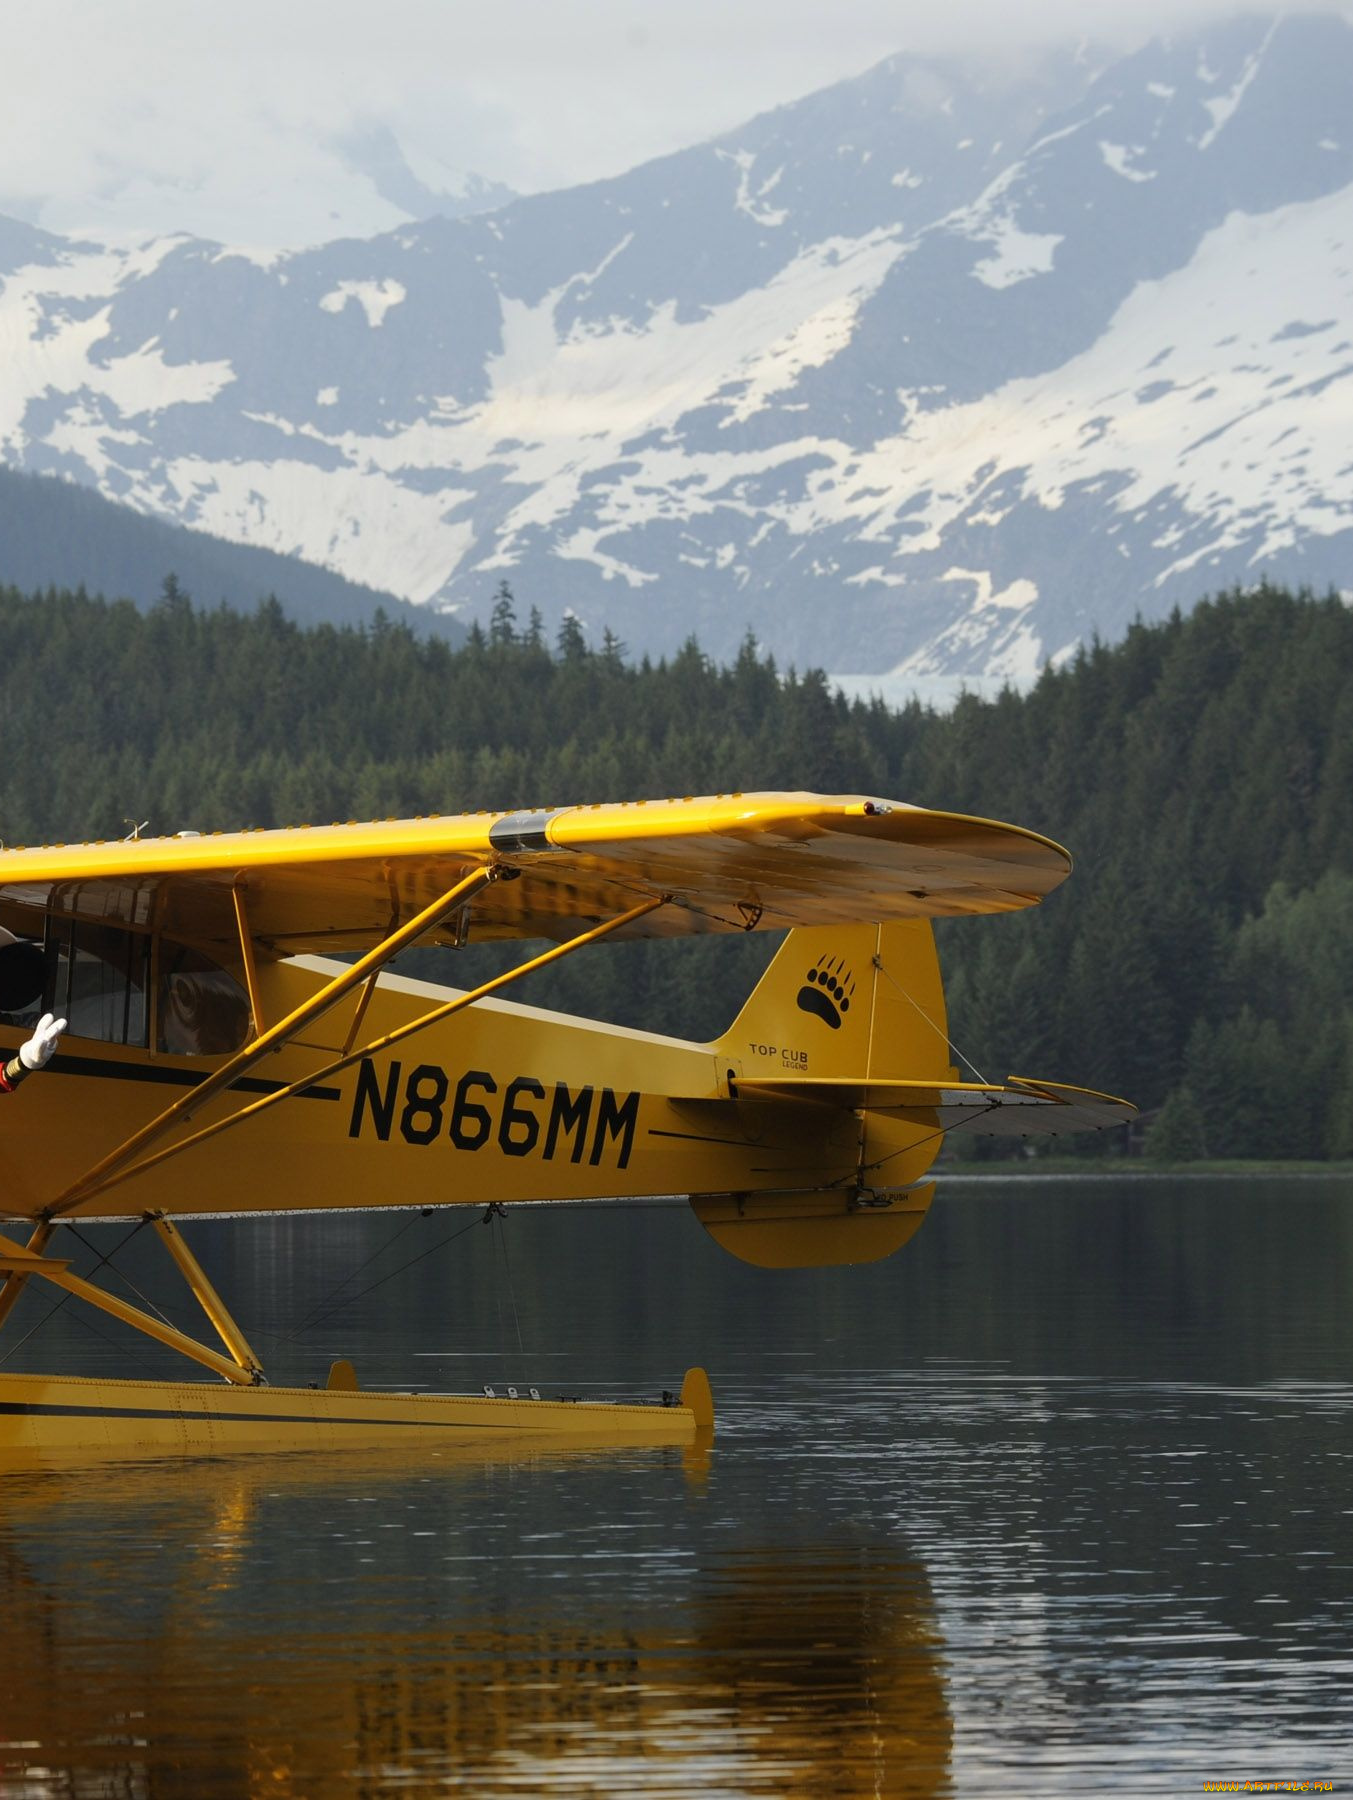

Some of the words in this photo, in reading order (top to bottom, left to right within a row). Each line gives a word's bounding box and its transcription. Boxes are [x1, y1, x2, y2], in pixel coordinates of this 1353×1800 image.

[749, 1043, 777, 1057] TOP
[781, 1049, 808, 1063] CUB
[782, 1060, 809, 1072] LEGEND
[349, 1058, 641, 1170] N866MM
